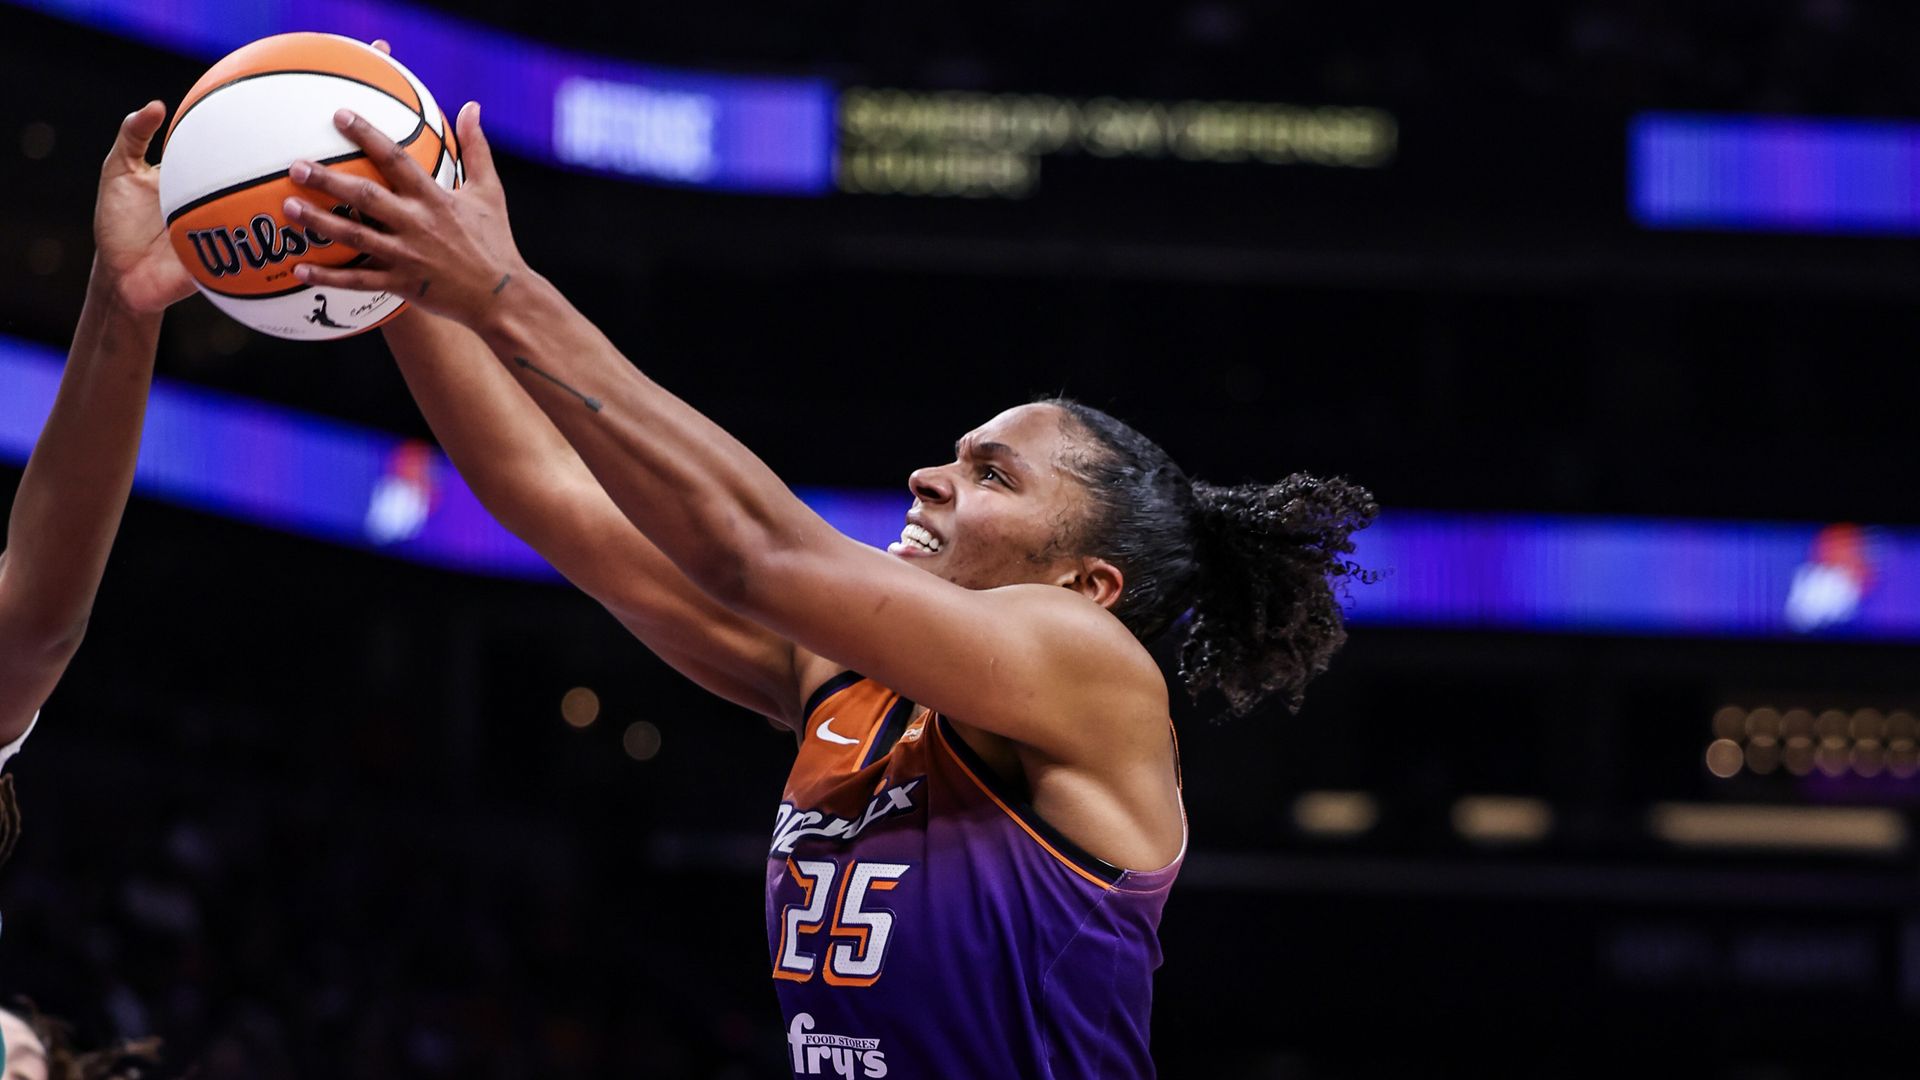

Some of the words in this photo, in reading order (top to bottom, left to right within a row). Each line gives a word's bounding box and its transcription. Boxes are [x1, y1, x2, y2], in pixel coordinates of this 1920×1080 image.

[187, 204, 368, 278] Wils
[774, 859, 910, 986] 25
[787, 1012, 888, 1080] fry's
[805, 1035, 836, 1045] FOOD
[838, 1036, 877, 1049] STORES
